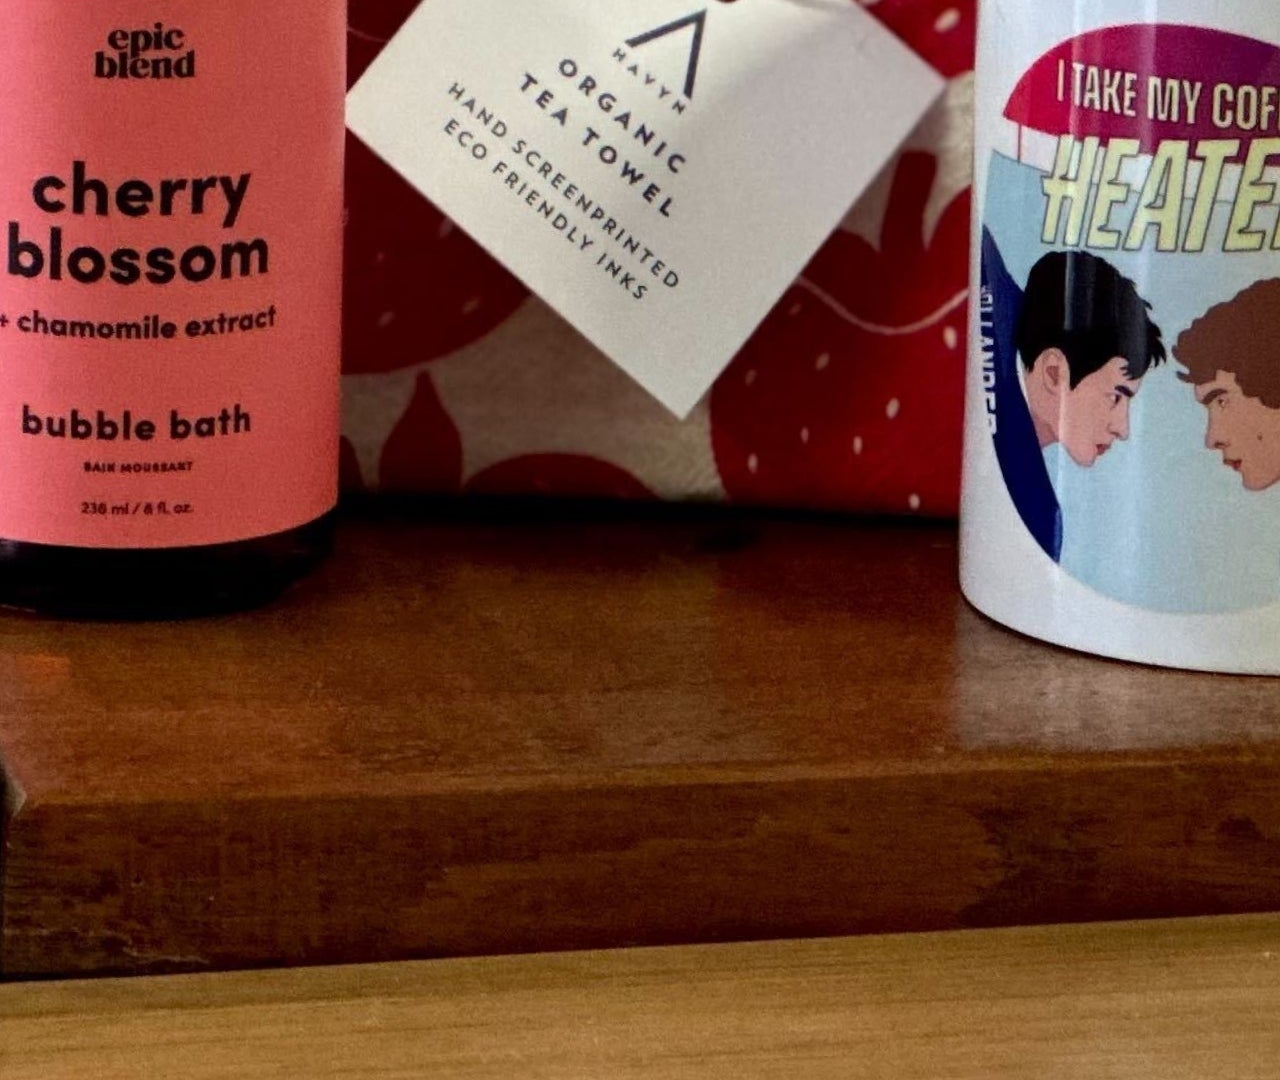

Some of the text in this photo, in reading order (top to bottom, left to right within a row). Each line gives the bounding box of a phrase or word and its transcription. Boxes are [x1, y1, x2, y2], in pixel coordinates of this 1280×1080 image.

[94, 50, 196, 79] blend
[107, 22, 184, 57] epic
[613, 48, 687, 115] HAVYN
[1057, 59, 1065, 101] I
[1072, 62, 1136, 119] TAKE
[1147, 76, 1203, 124] MY
[520, 72, 674, 218] TEA TOWEL
[559, 58, 686, 174] ORGANIC
[32, 160, 251, 228] cherry
[443, 118, 649, 300] ECO FRIENDLY INKS
[447, 82, 680, 289] HAND SCREENPRINTED
[7, 221, 269, 285] blossom
[17, 310, 176, 340] chamomile
[185, 306, 277, 338] extract
[22, 404, 251, 441] bubble bath
[83, 461, 116, 473] BAIN
